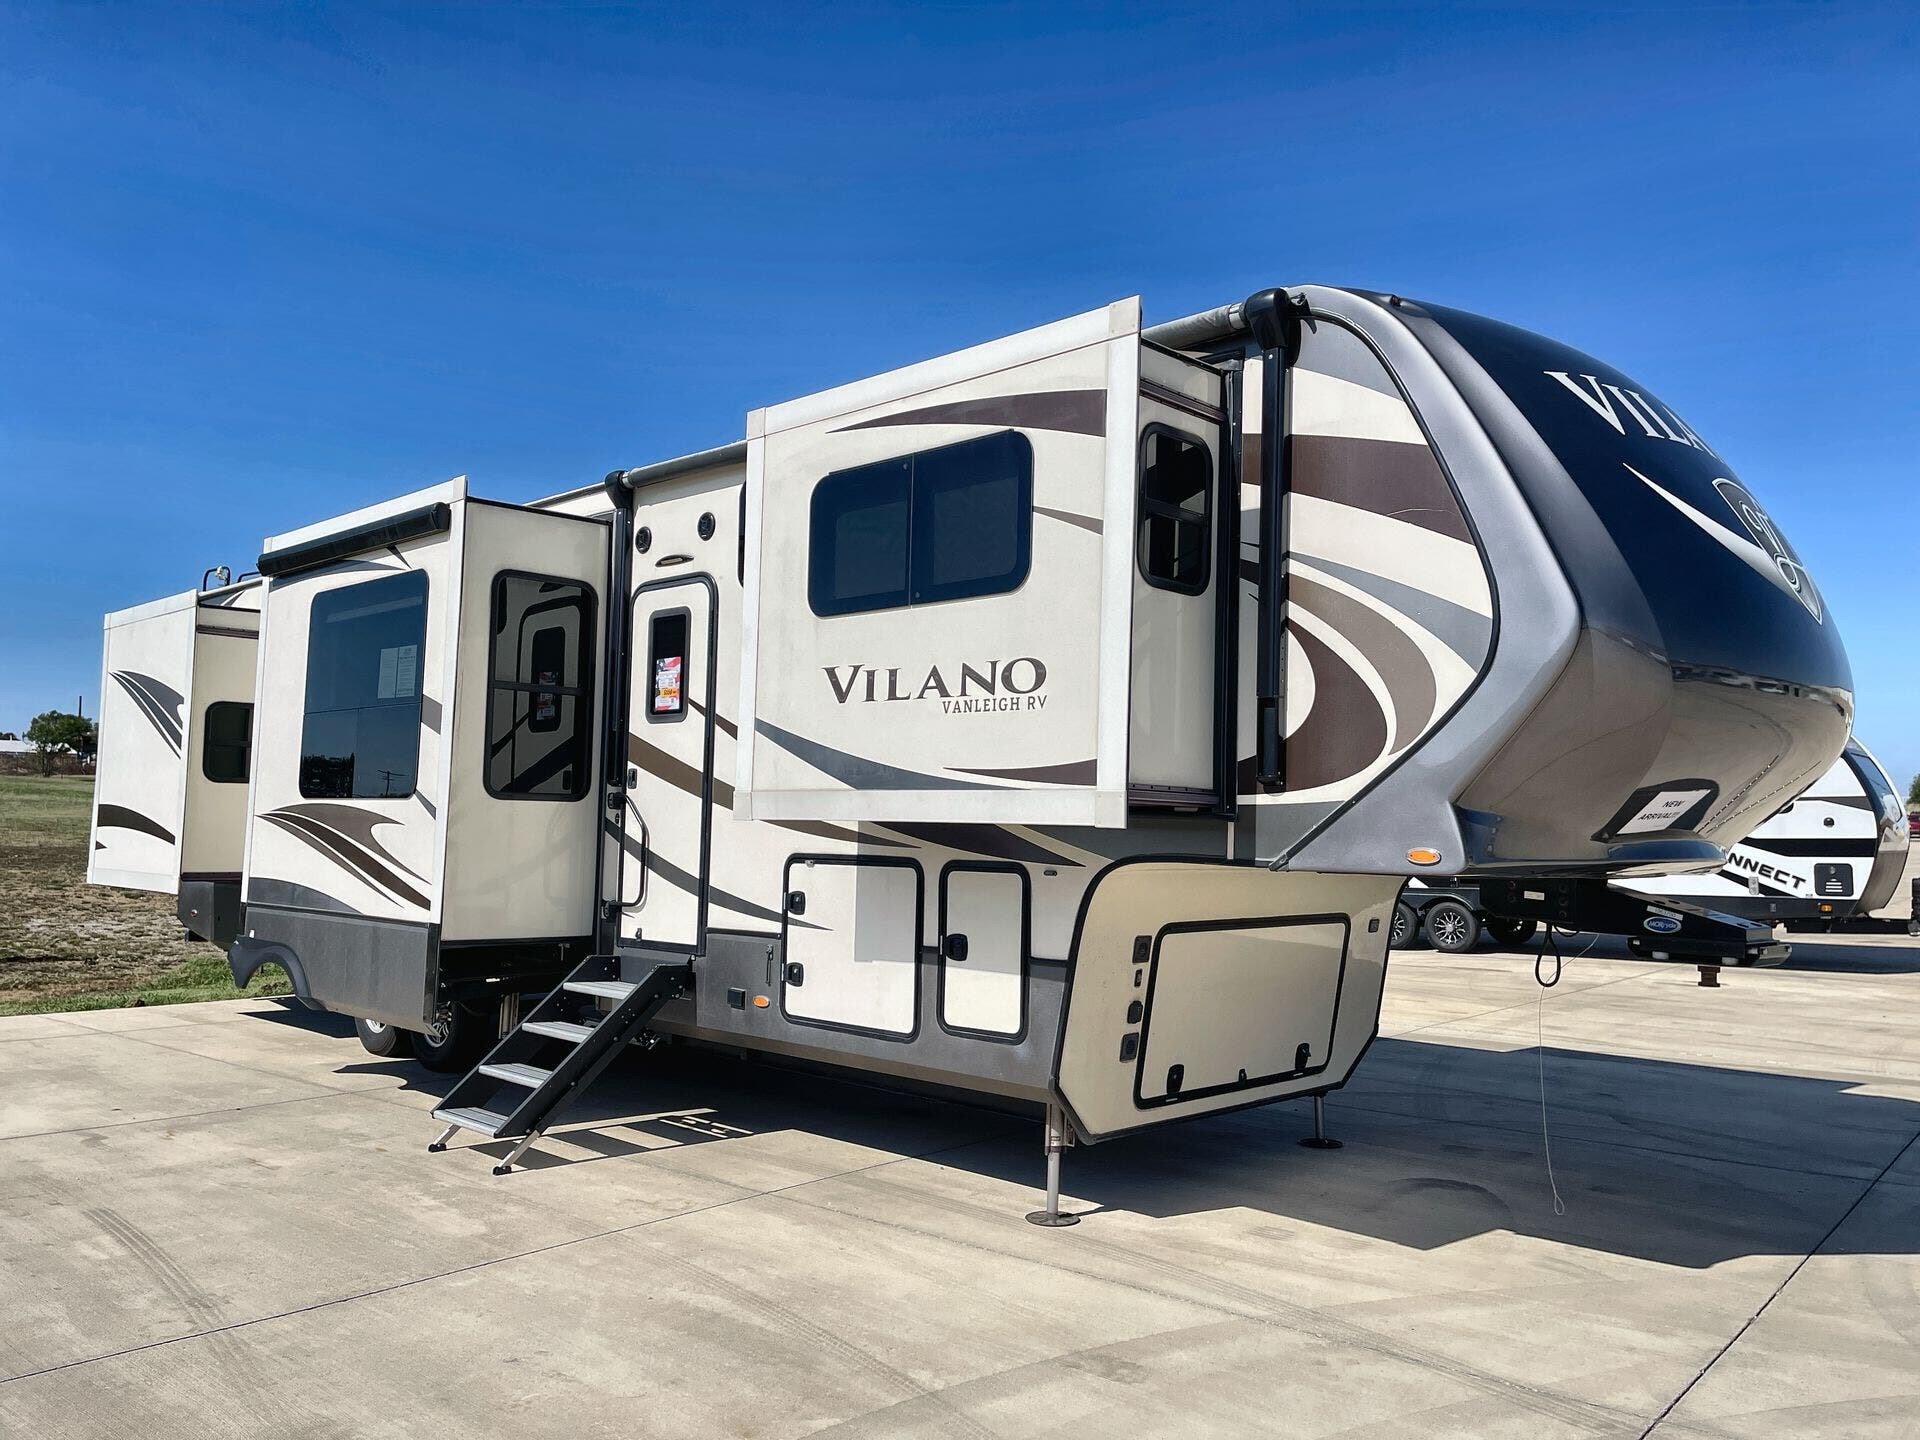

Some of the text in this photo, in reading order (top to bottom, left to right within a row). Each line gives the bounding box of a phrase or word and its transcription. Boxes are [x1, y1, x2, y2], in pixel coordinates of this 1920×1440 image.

[822, 657, 1047, 704] VILANO
[942, 694, 1048, 714] VANLEIGH RV
[1662, 800, 1685, 808] NEW
